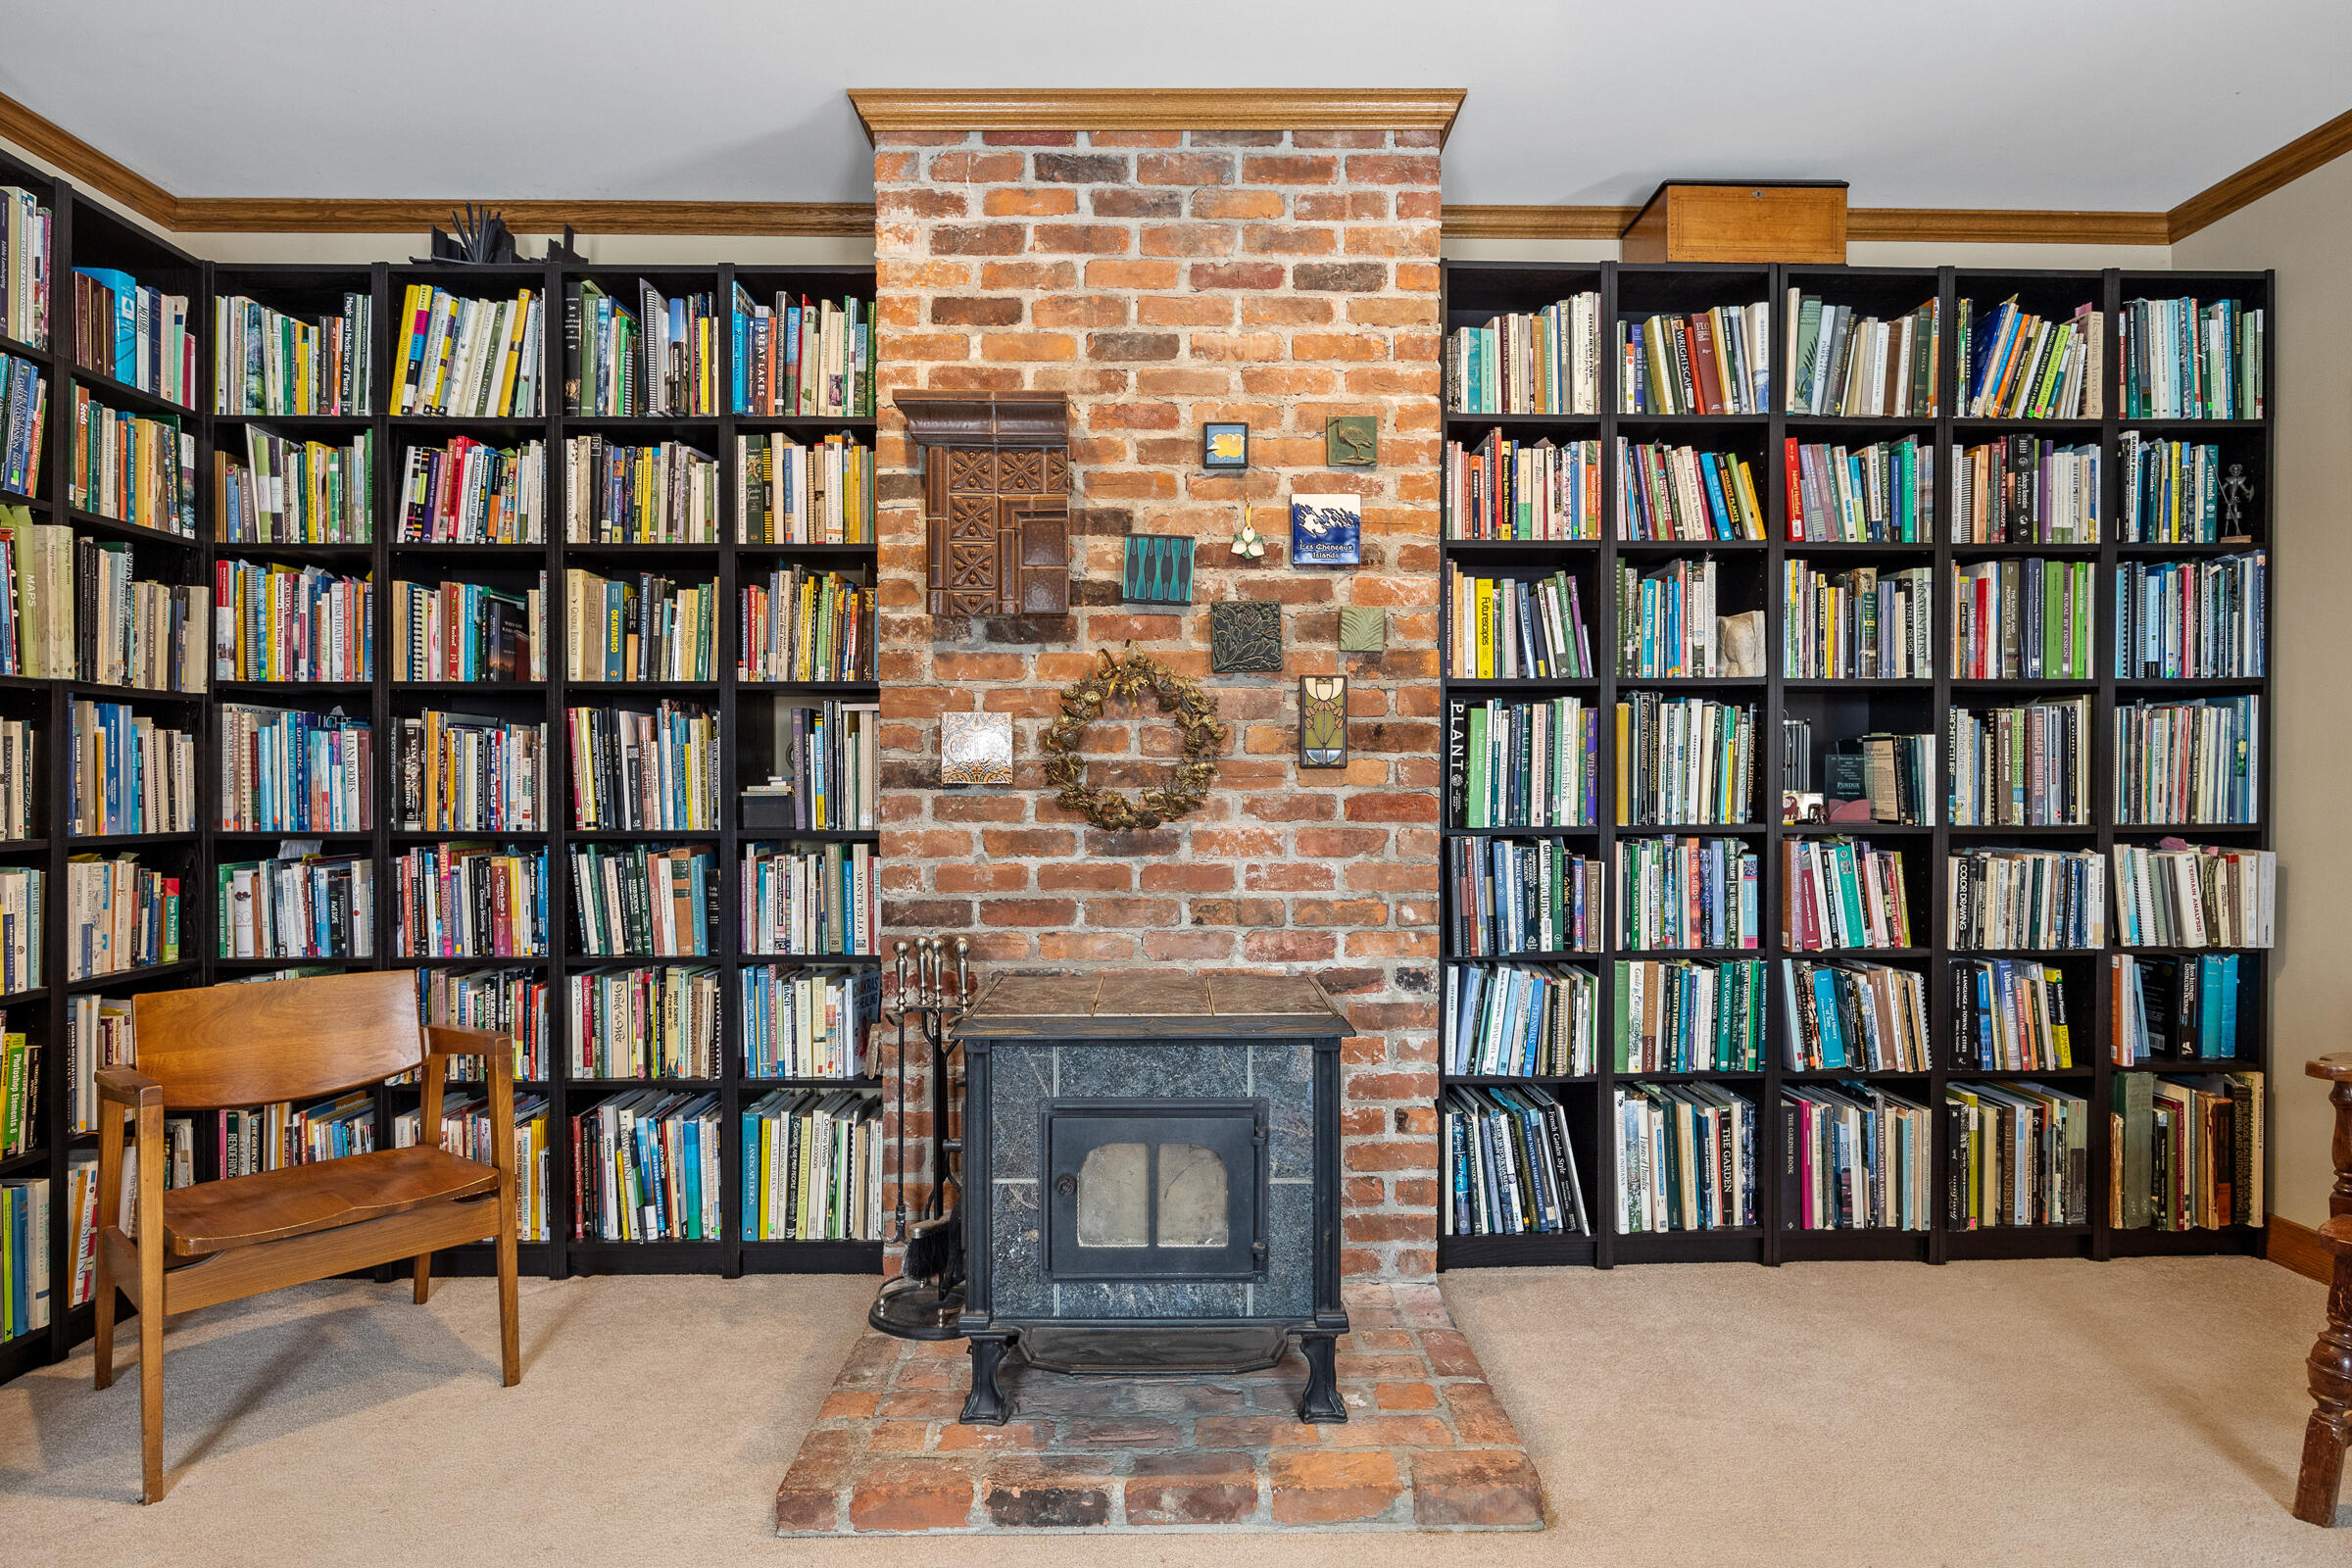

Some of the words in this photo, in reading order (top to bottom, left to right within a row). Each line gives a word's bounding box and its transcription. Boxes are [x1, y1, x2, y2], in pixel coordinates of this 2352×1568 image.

[344, 297, 353, 317] Magic
[343, 333, 352, 363] Medicine
[2091, 318, 2101, 361] Resettling
[485, 345, 495, 376] BEAUTIFUL
[16, 378, 24, 405] GARDEN
[341, 374, 350, 395] Plants
[470, 359, 482, 400] EXPLANATIONS
[479, 379, 489, 407] EVIDENCE
[2091, 368, 2100, 399] America
[12, 408, 23, 448] COMPANION
[79, 403, 88, 424] Seeds
[1724, 469, 1733, 496] INVASIVE
[1730, 498, 1740, 521] PLANTS
[1298, 539, 1313, 550] Les
[26, 575, 35, 607] MAPS
[570, 608, 579, 630] GENERAL
[1481, 597, 1490, 645] Futurescapes
[570, 632, 579, 655] ECOLOGY
[347, 735, 356, 758] LEAN
[1452, 705, 1463, 770] PLANT
[2034, 713, 2043, 754] LANDSCAPE
[2034, 757, 2043, 796] GUIDELINES
[441, 881, 451, 939] PHOTOGRAPHY
[1541, 876, 1549, 919] REVOLUTION
[2192, 899, 2202, 932] ANALYSIS
[2003, 971, 2012, 991] Urban
[2005, 993, 2014, 1007] Land
[1528, 1004, 1539, 1043] PERENNIALS
[2008, 1023, 2018, 1051] Planning
[620, 1124, 630, 1149] DRAW
[1548, 1112, 1559, 1131] French
[228, 1134, 237, 1177] RENDERING
[1528, 1143, 1537, 1166] NATURAL
[1552, 1134, 1563, 1155] Garden
[622, 1156, 632, 1182] PAINT
[1556, 1158, 1566, 1173] Style
[1723, 1152, 1732, 1192] GARDEN
[77, 1229, 90, 1280] SEWING
